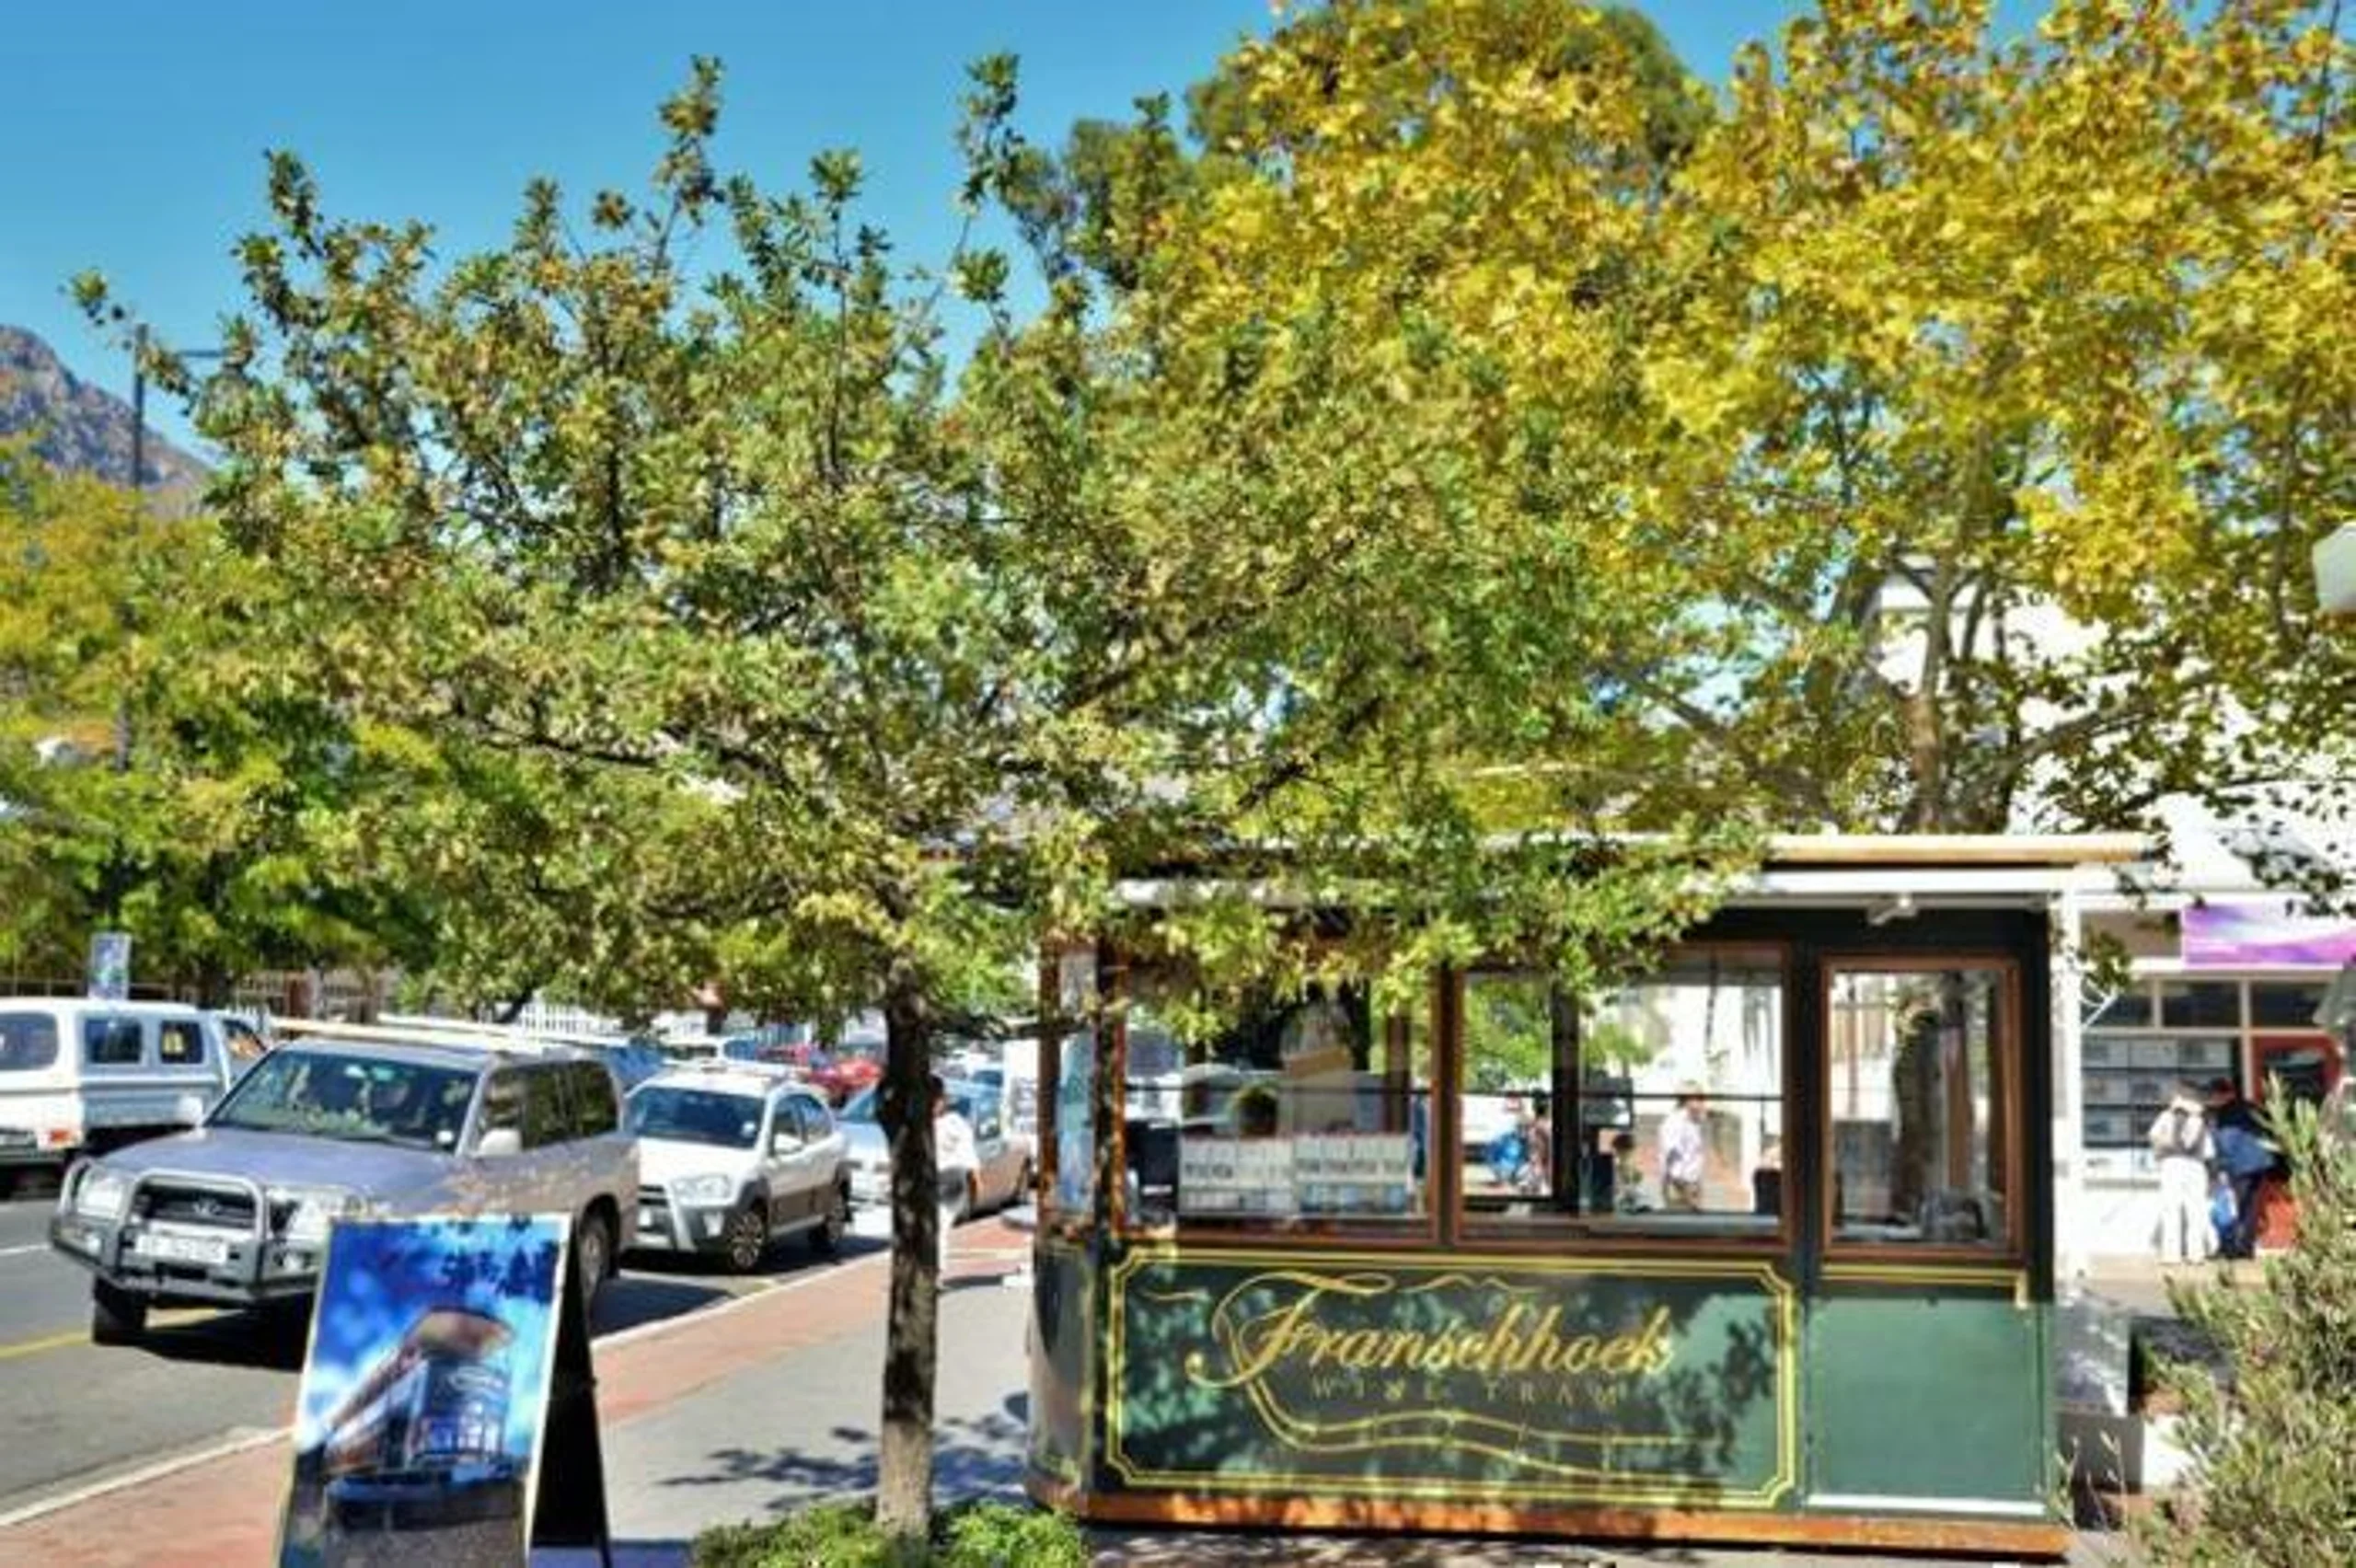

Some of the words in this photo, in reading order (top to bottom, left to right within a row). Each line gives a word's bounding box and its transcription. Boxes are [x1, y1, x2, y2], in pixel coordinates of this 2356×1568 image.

[1184, 1272, 1674, 1388] Franschhoek
[1311, 1377, 1454, 1401] WINE
[1483, 1378, 1627, 1408] TRAM
